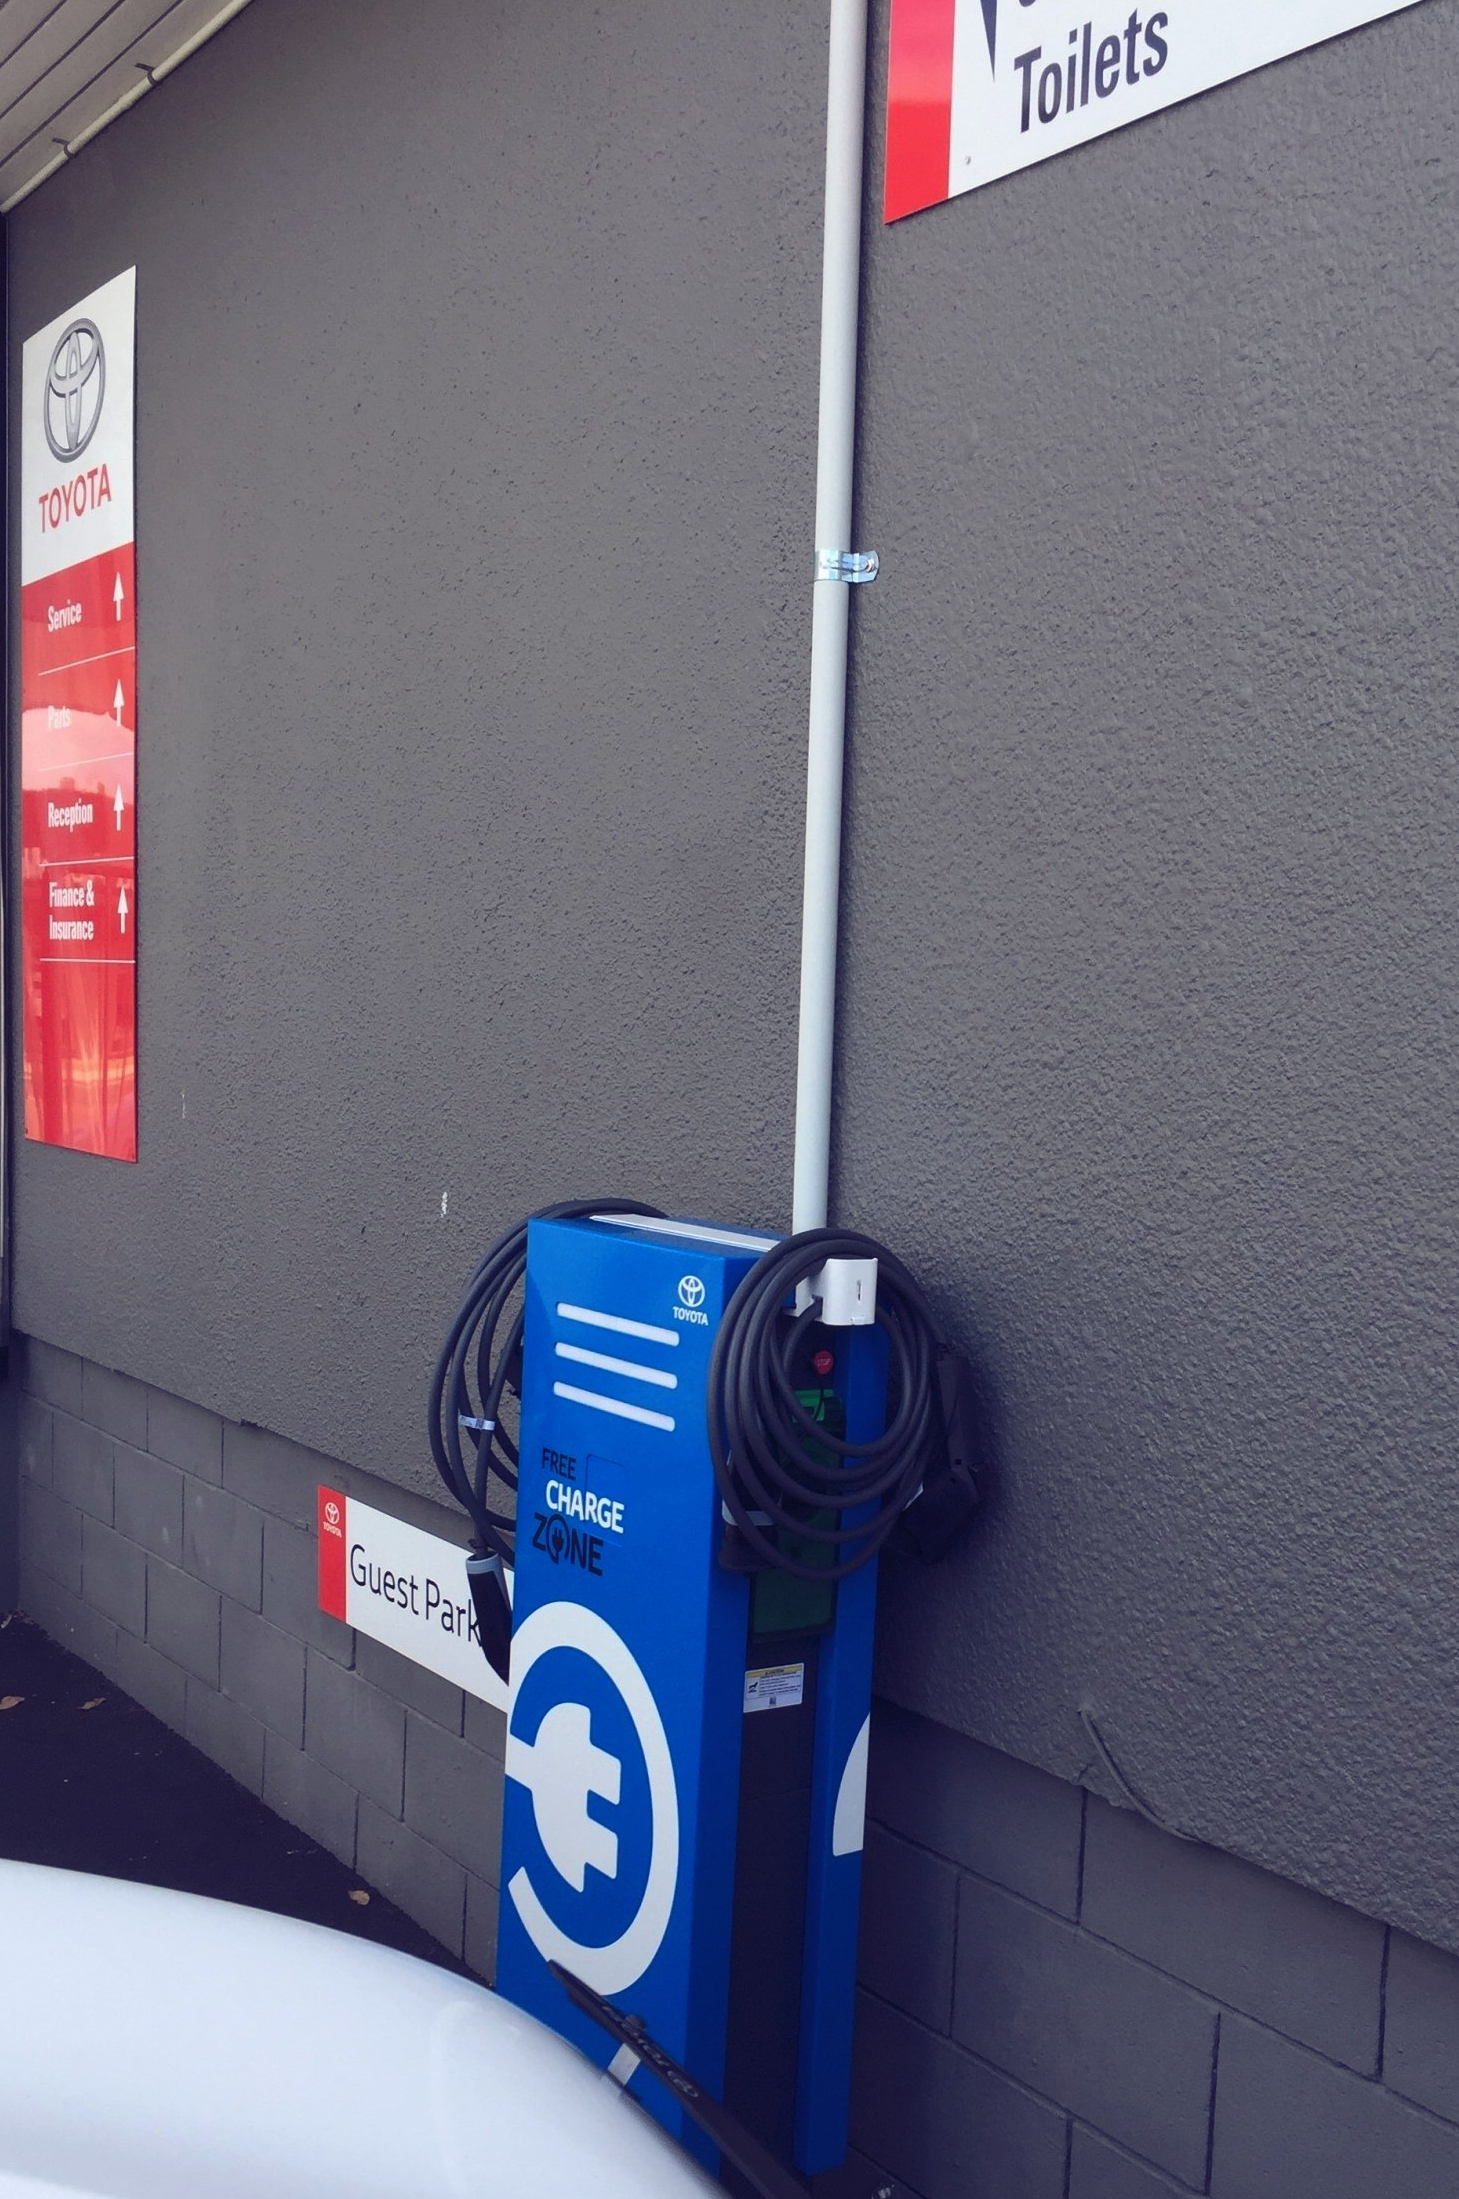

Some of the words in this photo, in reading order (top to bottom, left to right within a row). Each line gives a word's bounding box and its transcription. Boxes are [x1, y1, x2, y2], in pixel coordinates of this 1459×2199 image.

[1014, 8, 1169, 134] Toilets
[39, 463, 112, 533] TOYOTA
[48, 600, 82, 633] Service
[48, 705, 71, 731] Parts
[48, 798, 94, 832] Reception
[49, 881, 85, 908] Finance
[86, 879, 95, 907] &
[49, 914, 94, 941] Insurance
[673, 1306, 709, 1326] TOYOTA
[541, 1447, 577, 1481] FREE
[545, 1479, 625, 1534] CHARGE
[322, 1521, 342, 1538] TOYOTA
[532, 1512, 604, 1577] ZONE
[350, 1544, 419, 1616] Guest
